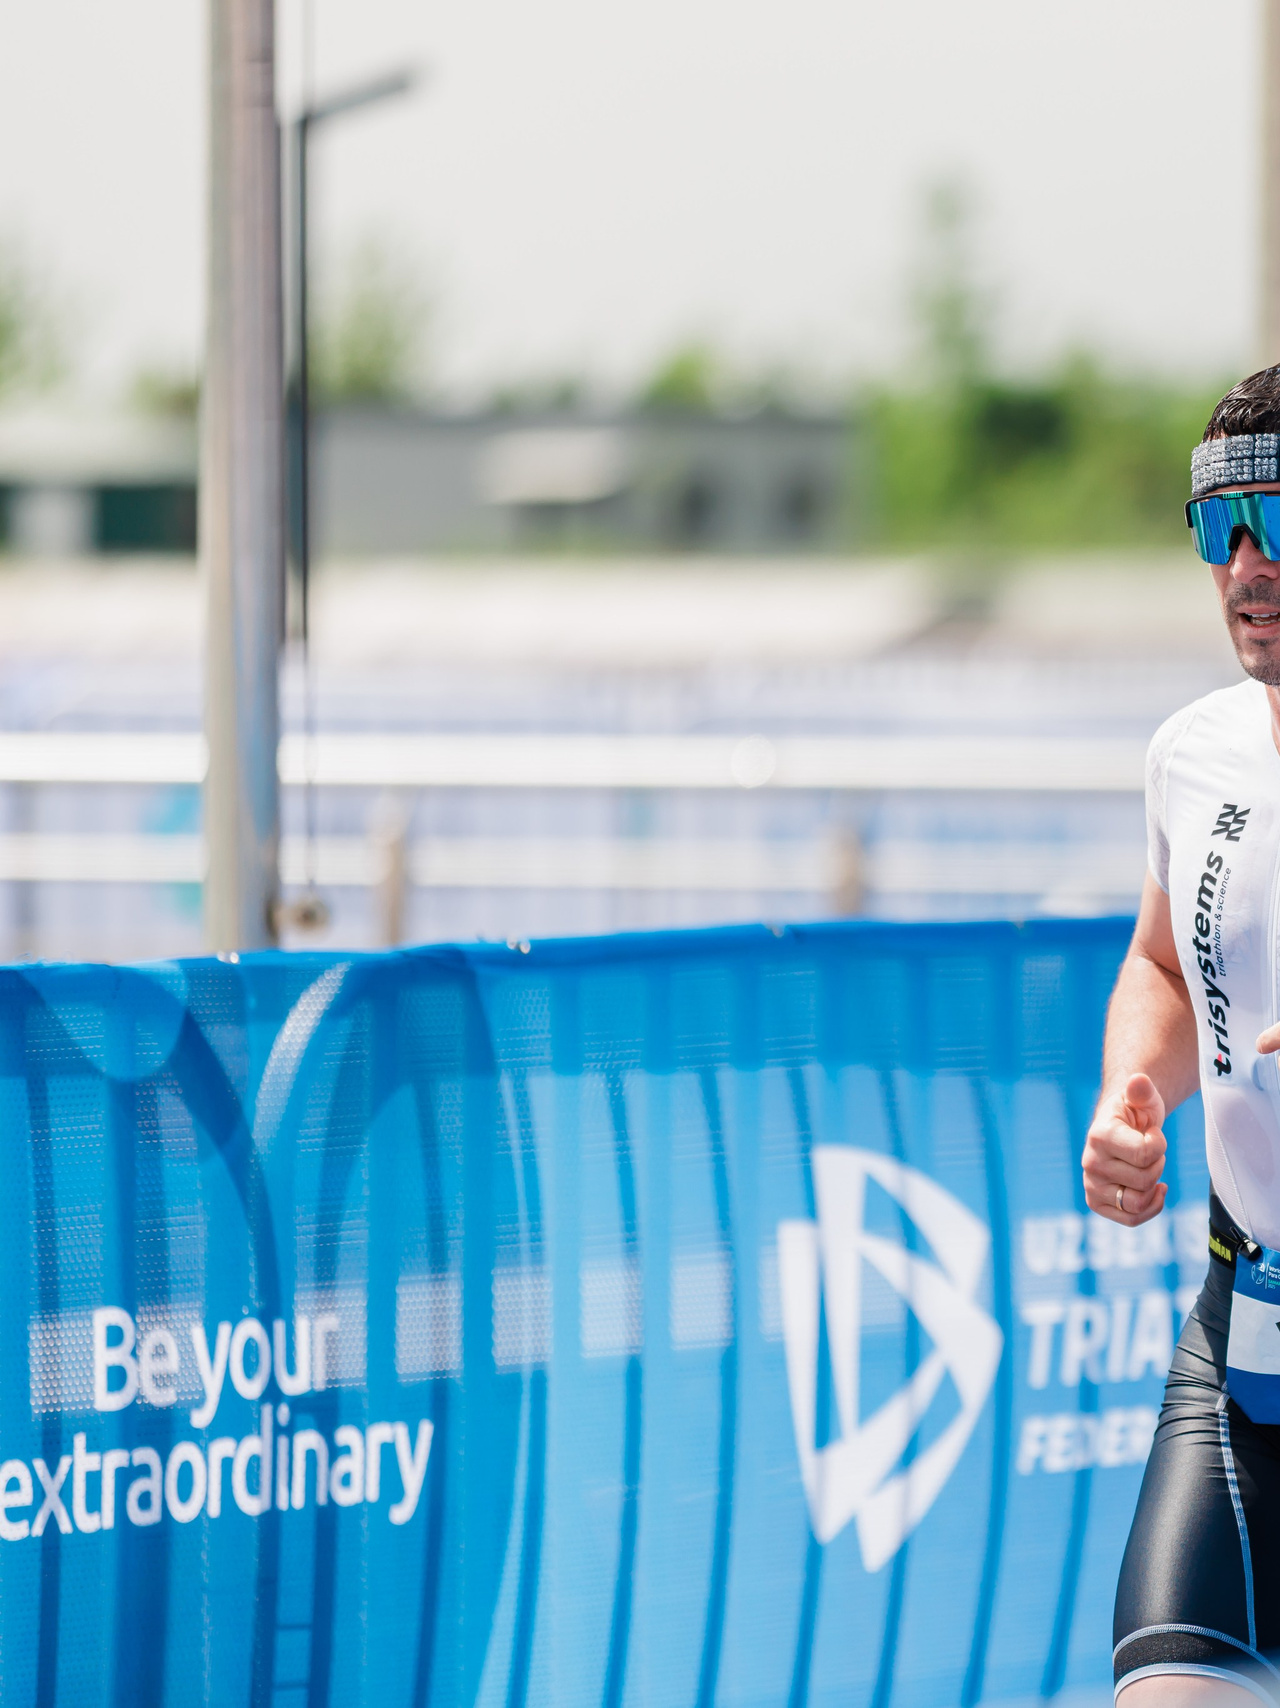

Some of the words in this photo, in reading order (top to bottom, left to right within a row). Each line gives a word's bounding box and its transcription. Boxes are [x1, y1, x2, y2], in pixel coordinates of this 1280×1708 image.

[1216, 867, 1232, 912] science
[1190, 850, 1232, 1077] trisystems
[1212, 923, 1227, 977] triathlon
[1268, 1271, 1278, 1279] Para
[92, 1305, 179, 1413] Be
[190, 1313, 339, 1428] your
[0, 1402, 434, 1541] extraordinary
